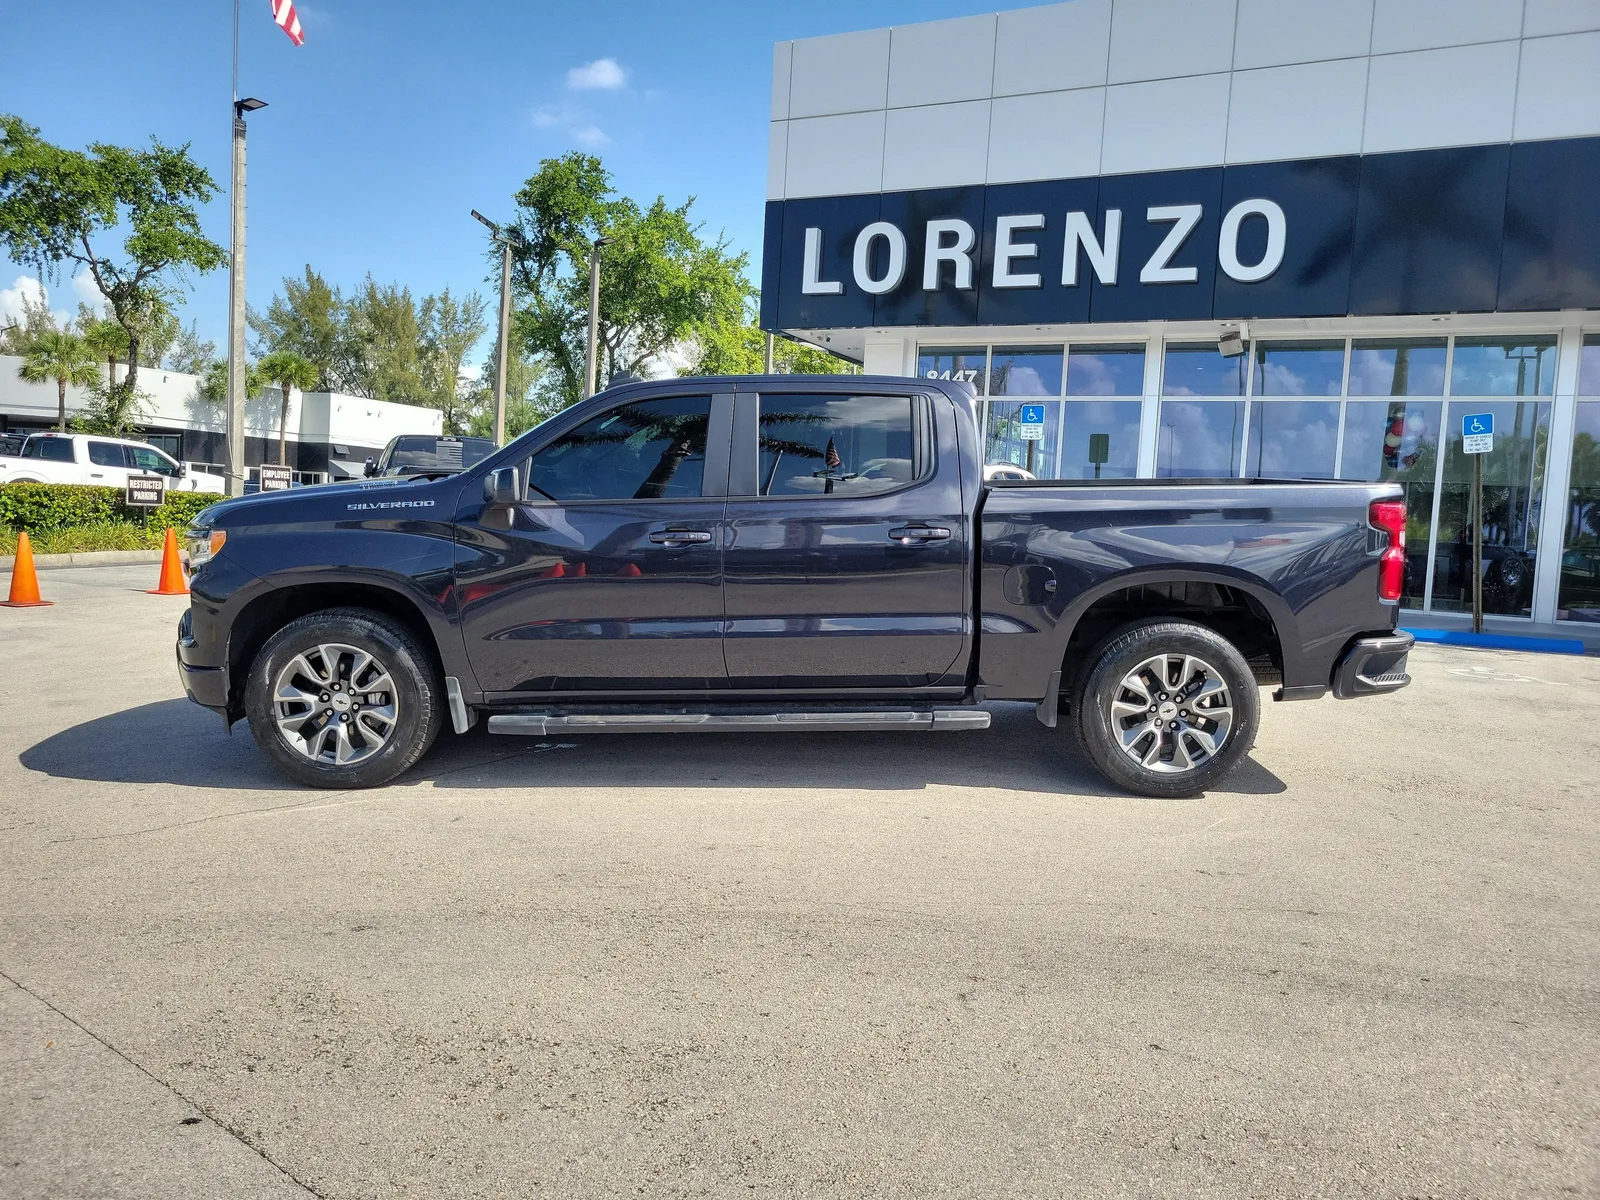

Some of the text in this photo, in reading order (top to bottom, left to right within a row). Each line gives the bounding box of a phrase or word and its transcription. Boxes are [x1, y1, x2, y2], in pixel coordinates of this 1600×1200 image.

[801, 198, 1287, 296] LORENZO
[262, 469, 291, 479] EMPLOYEE
[129, 479, 163, 490] RESTRICTED
[264, 479, 288, 489] PARKING
[133, 490, 158, 501] PARKING
[346, 500, 435, 511] SILVERADO
